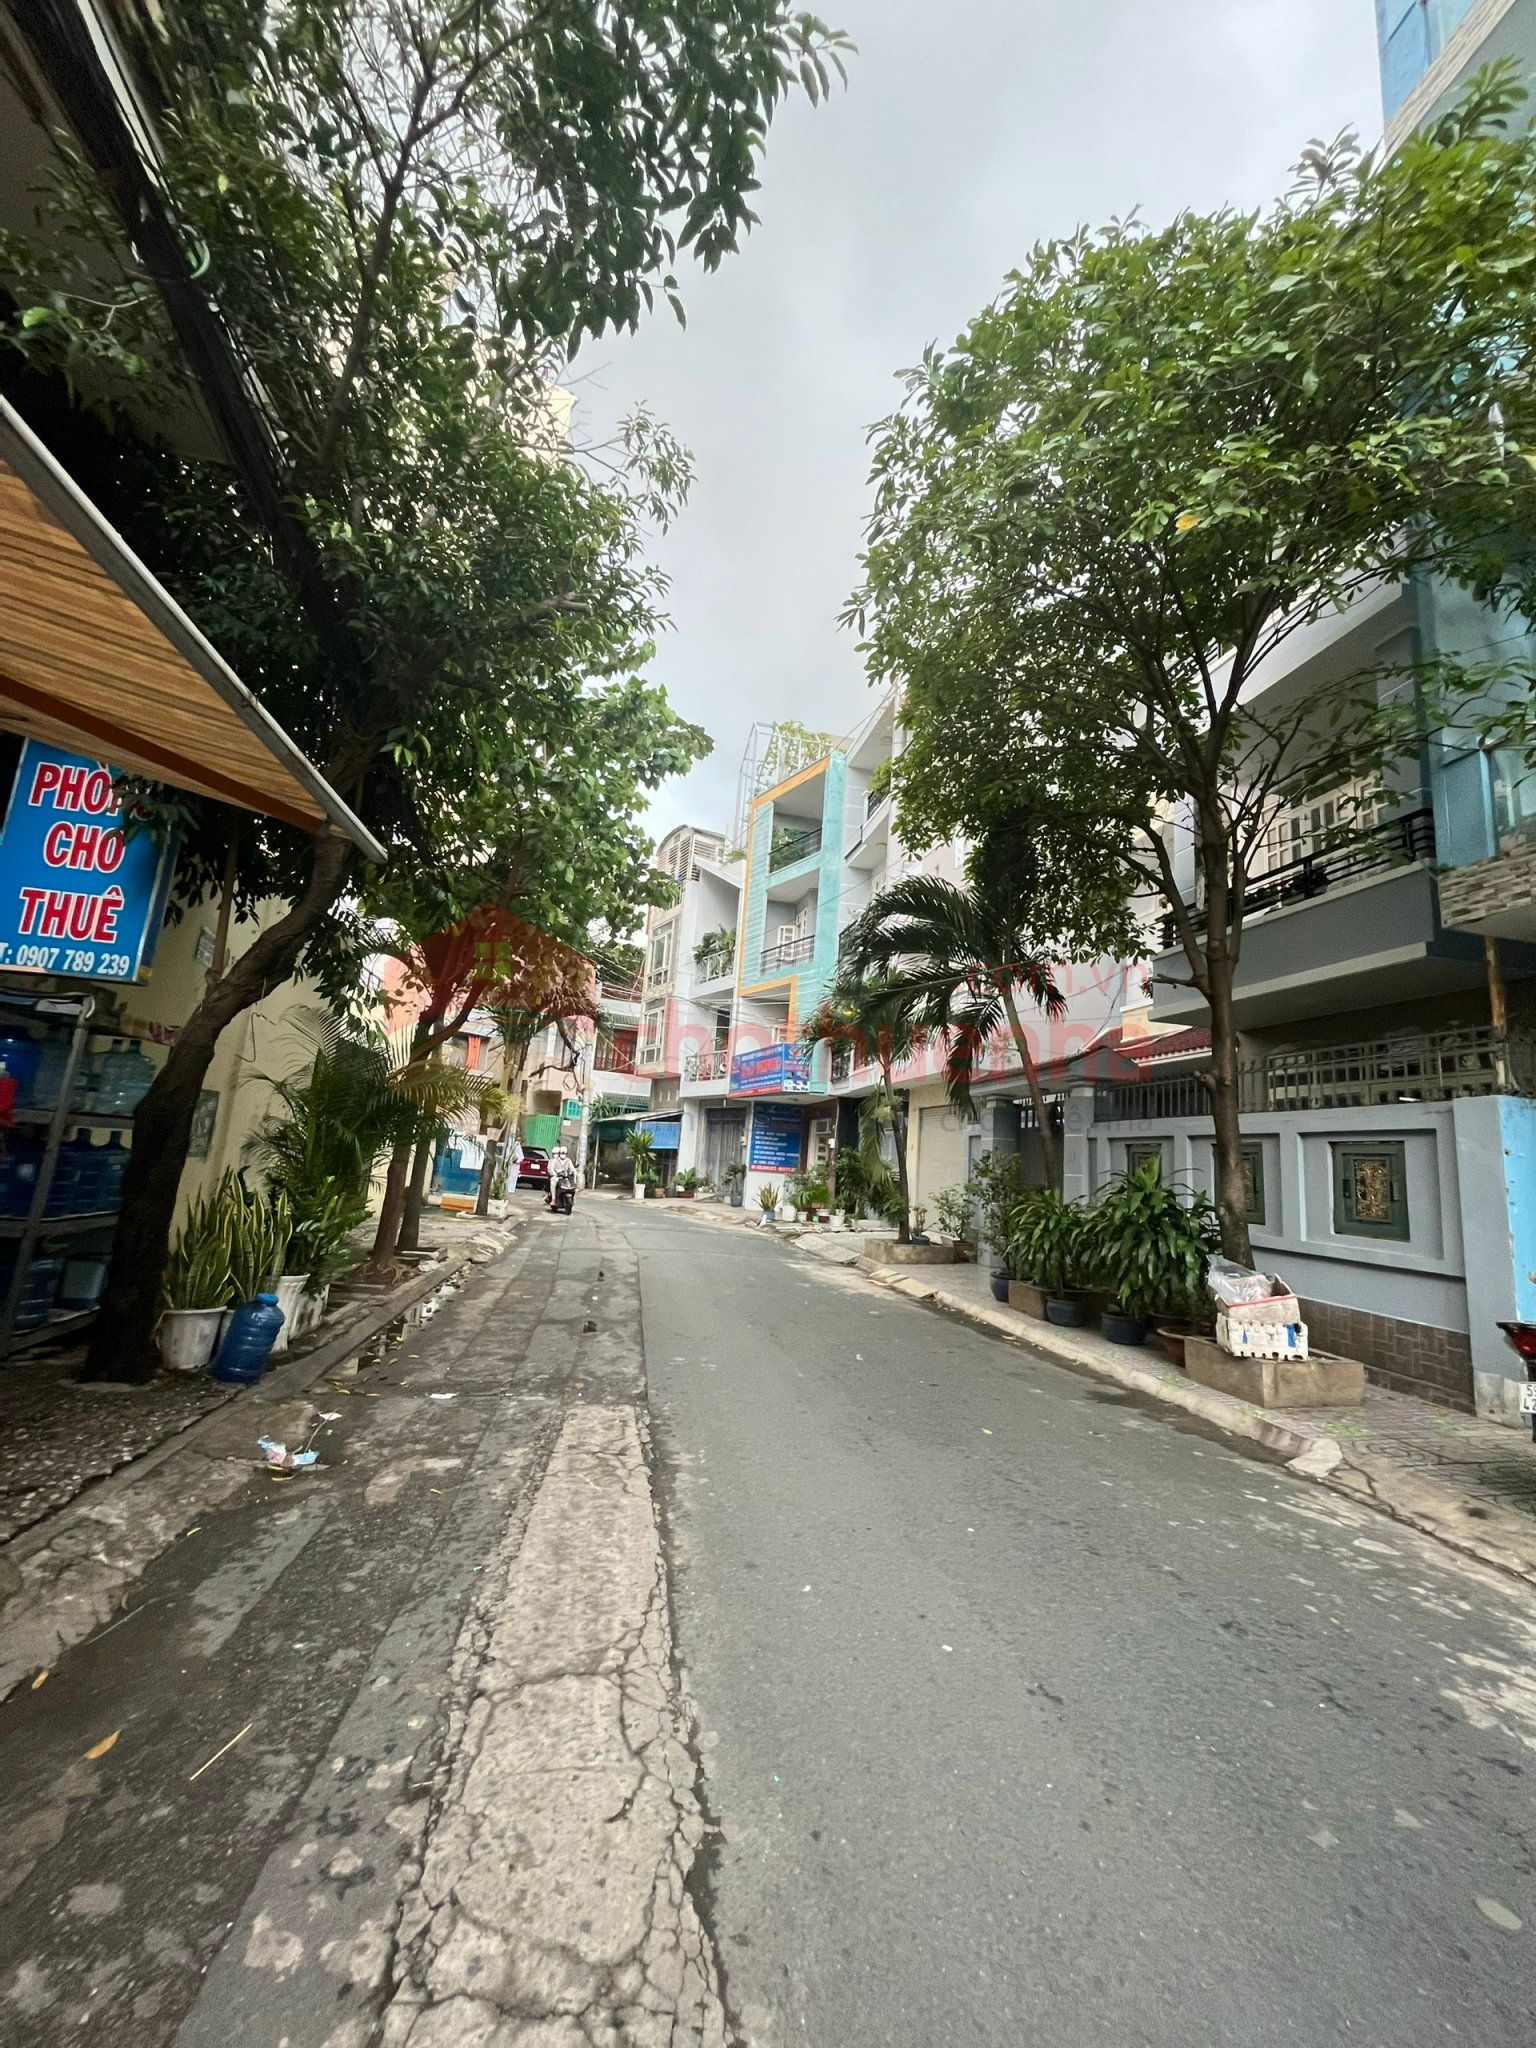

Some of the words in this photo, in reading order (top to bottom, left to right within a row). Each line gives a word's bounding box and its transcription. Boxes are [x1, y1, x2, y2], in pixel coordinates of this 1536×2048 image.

[28, 761, 152, 820] PHÒ
[43, 821, 125, 873] CHO
[18, 885, 124, 944] THUÊ
[16, 944, 60, 968] 0907
[62, 949, 94, 973] 789
[97, 953, 130, 976] 239
